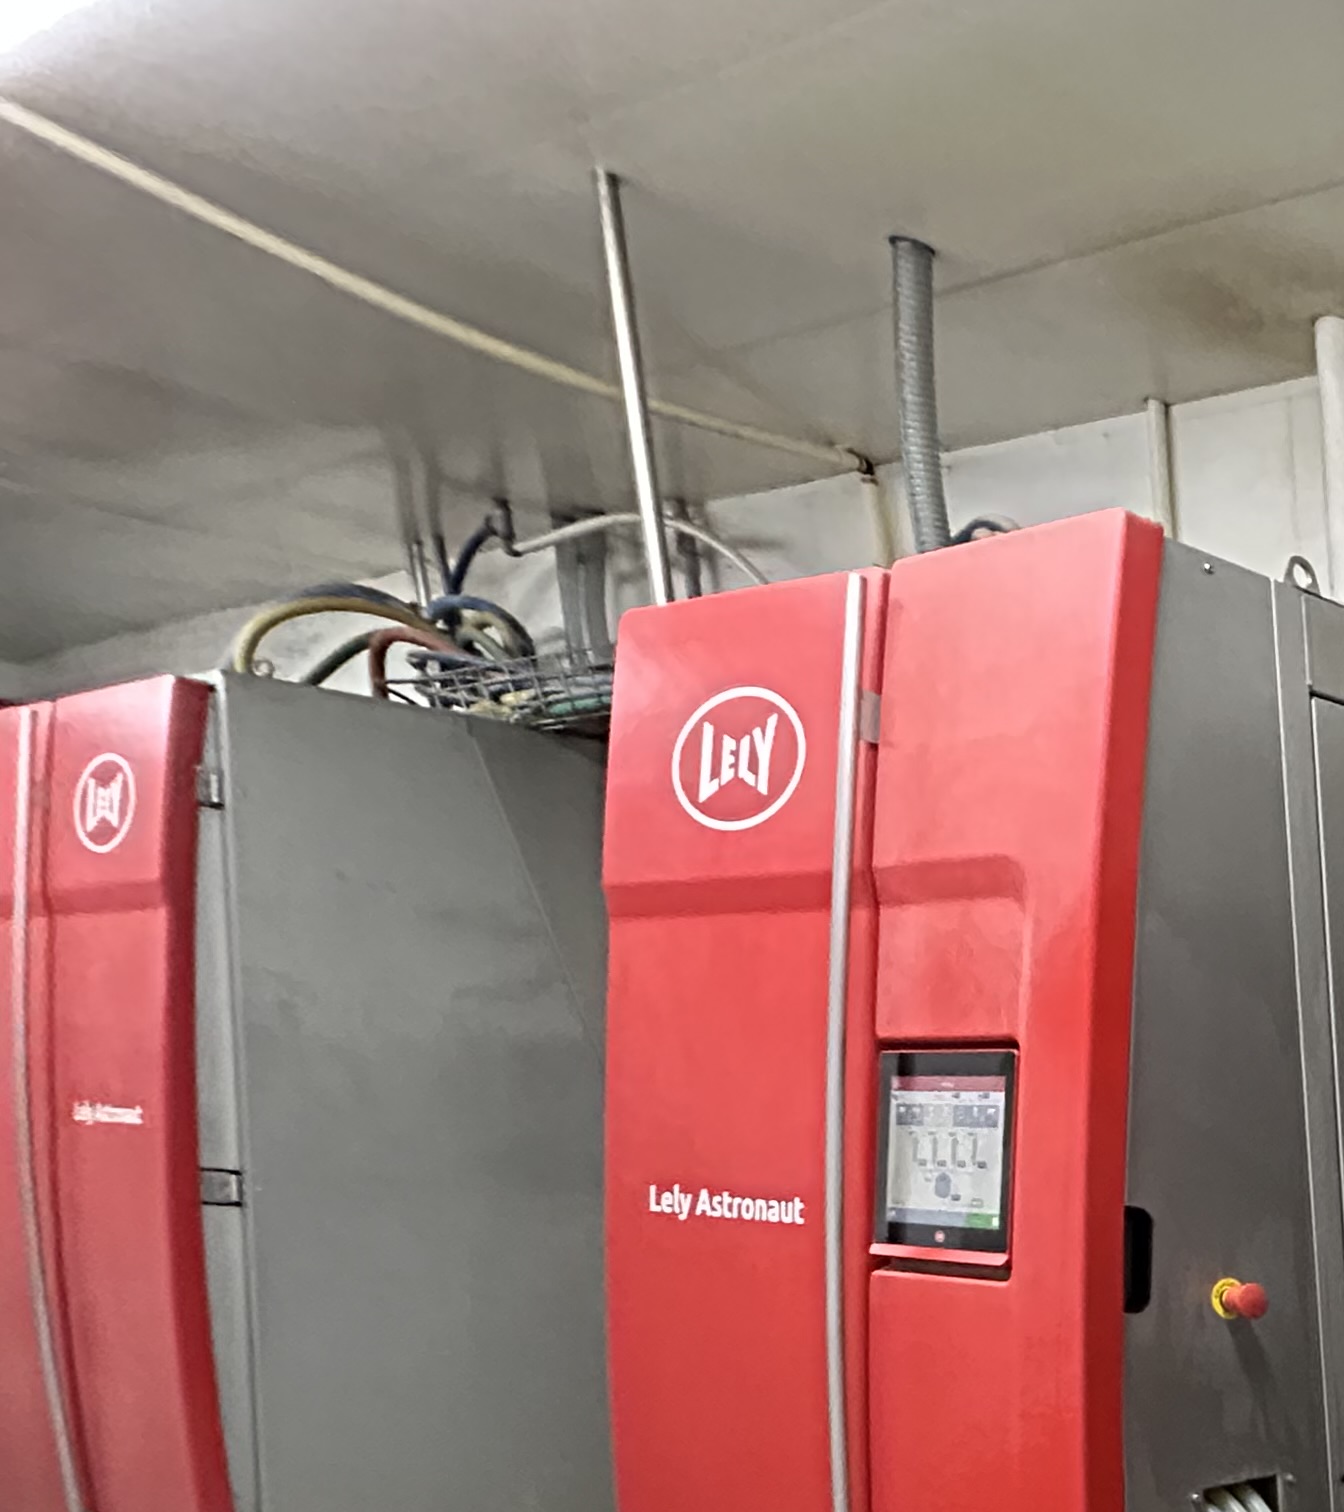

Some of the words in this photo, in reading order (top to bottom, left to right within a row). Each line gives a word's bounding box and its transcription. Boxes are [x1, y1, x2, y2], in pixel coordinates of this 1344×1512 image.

[698, 712, 778, 803] LELY
[649, 1184, 693, 1221] Lely
[695, 1188, 805, 1225] Astronaut
